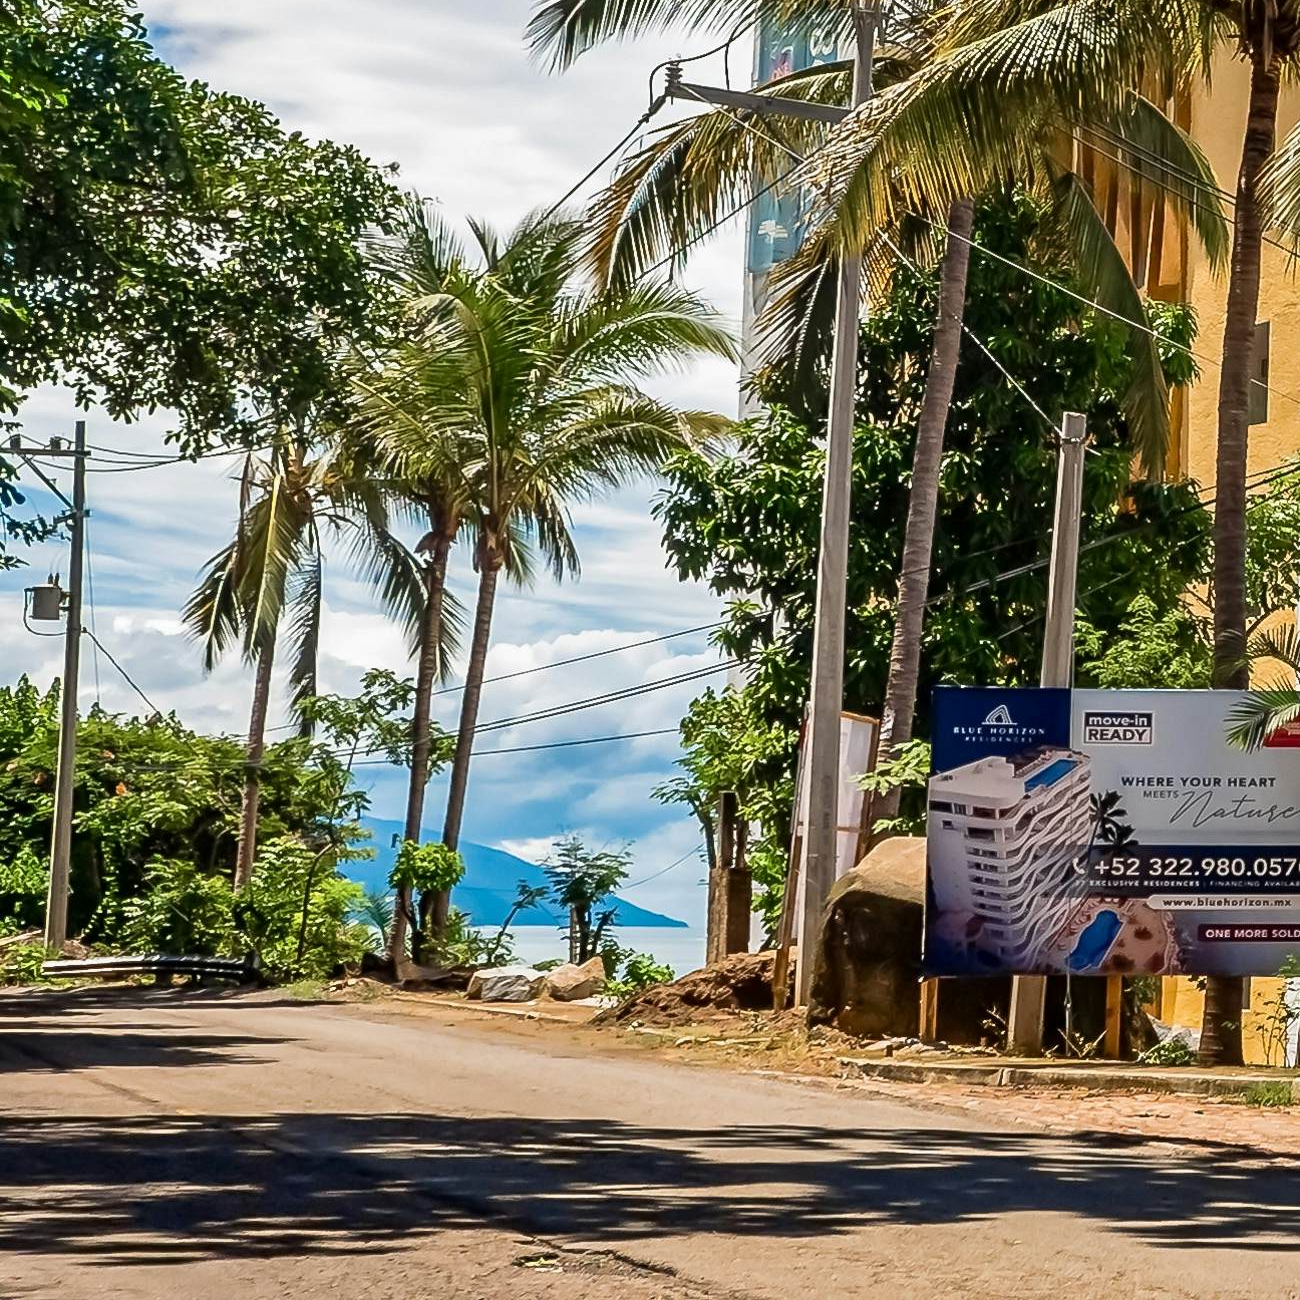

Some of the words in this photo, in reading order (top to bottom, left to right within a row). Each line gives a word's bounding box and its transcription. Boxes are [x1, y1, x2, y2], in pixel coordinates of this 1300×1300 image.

[1088, 714, 1148, 726] move-in
[953, 726, 982, 735] BLUE
[990, 727, 1046, 735] HORIZON
[1087, 728, 1147, 741] READY
[1121, 776, 1175, 787] WHERE
[1180, 777, 1222, 788] YOUR
[1227, 777, 1277, 788] HEART
[1143, 790, 1179, 799] MEETS
[1094, 858, 1140, 876] +52
[1162, 897, 1292, 907] www.bluehorizon.mx
[1205, 929, 1231, 938] ONE
[1234, 929, 1268, 938] MORE
